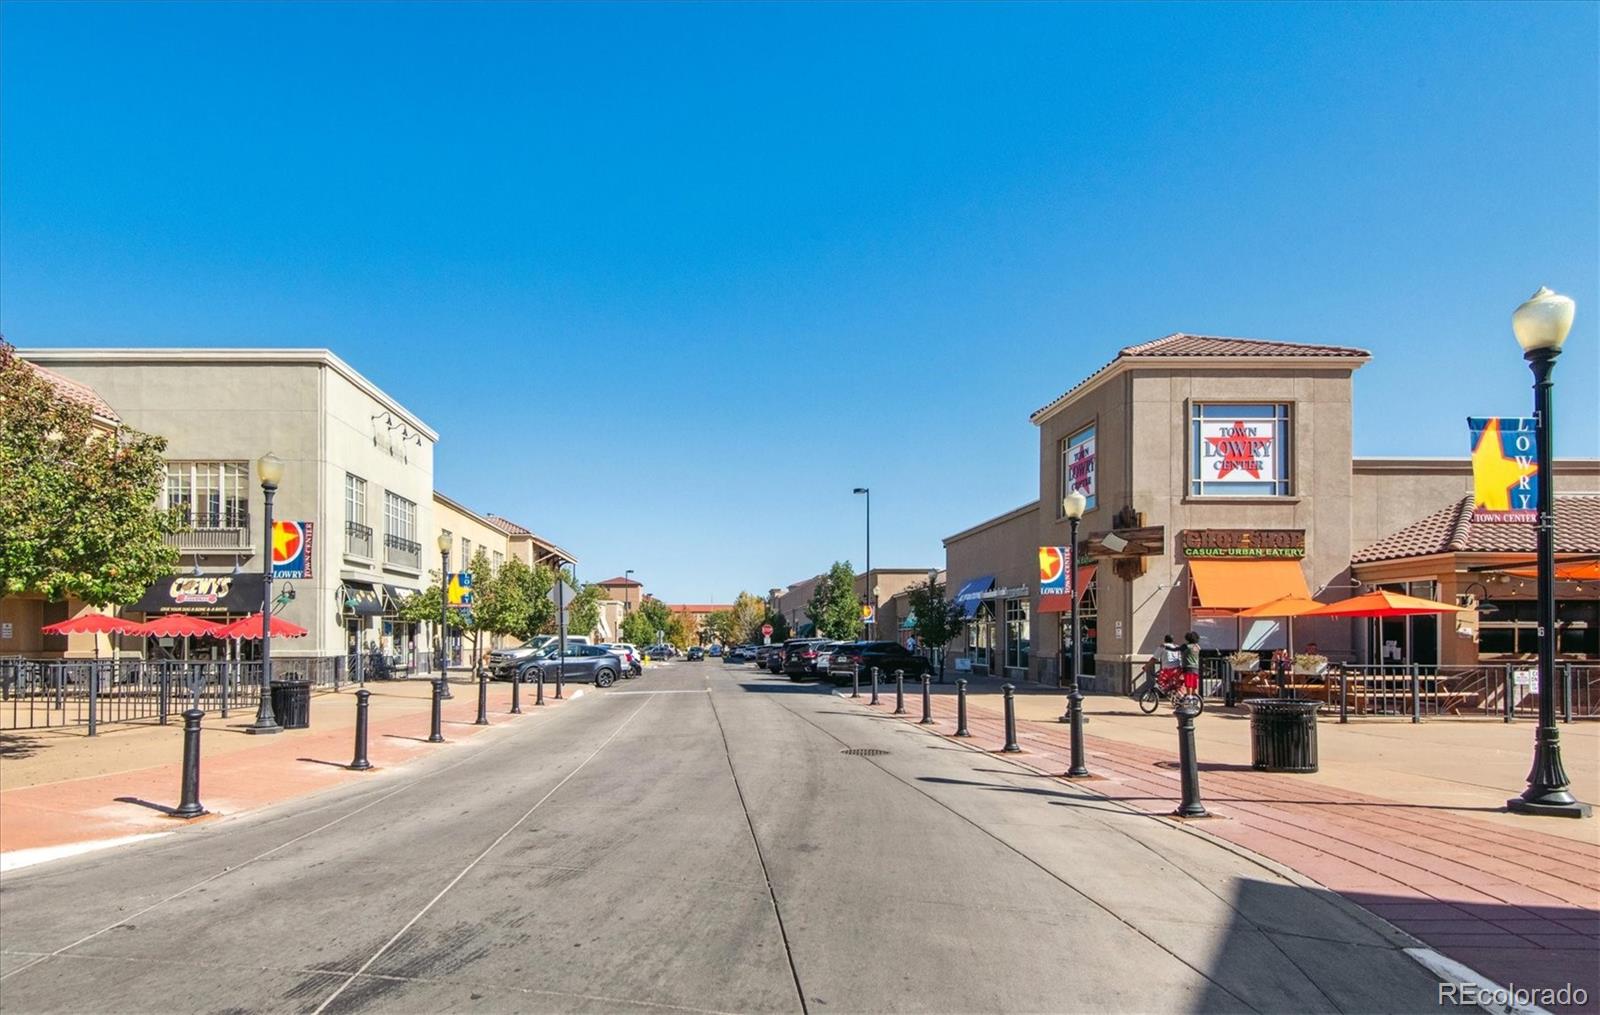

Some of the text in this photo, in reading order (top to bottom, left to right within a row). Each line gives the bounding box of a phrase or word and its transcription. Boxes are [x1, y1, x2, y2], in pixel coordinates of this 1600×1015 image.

[1219, 427, 1257, 437] TOWN
[1073, 447, 1089, 461] TOWN
[1204, 440, 1272, 458] LOWRY
[1068, 457, 1094, 482] LOWRY
[1213, 460, 1264, 471] CENTER
[1514, 417, 1534, 511] LOWRY
[1475, 513, 1537, 523] TOWN CENTER
[304, 522, 313, 577] TOWN CENTER
[1185, 548, 1304, 557] CASUAL URBAN EATERY
[273, 570, 303, 579] LOWRY
[1064, 547, 1073, 594] TOWN CENTER
[1040, 587, 1063, 595] LOWRY
[1537, 626, 1545, 637] 6
